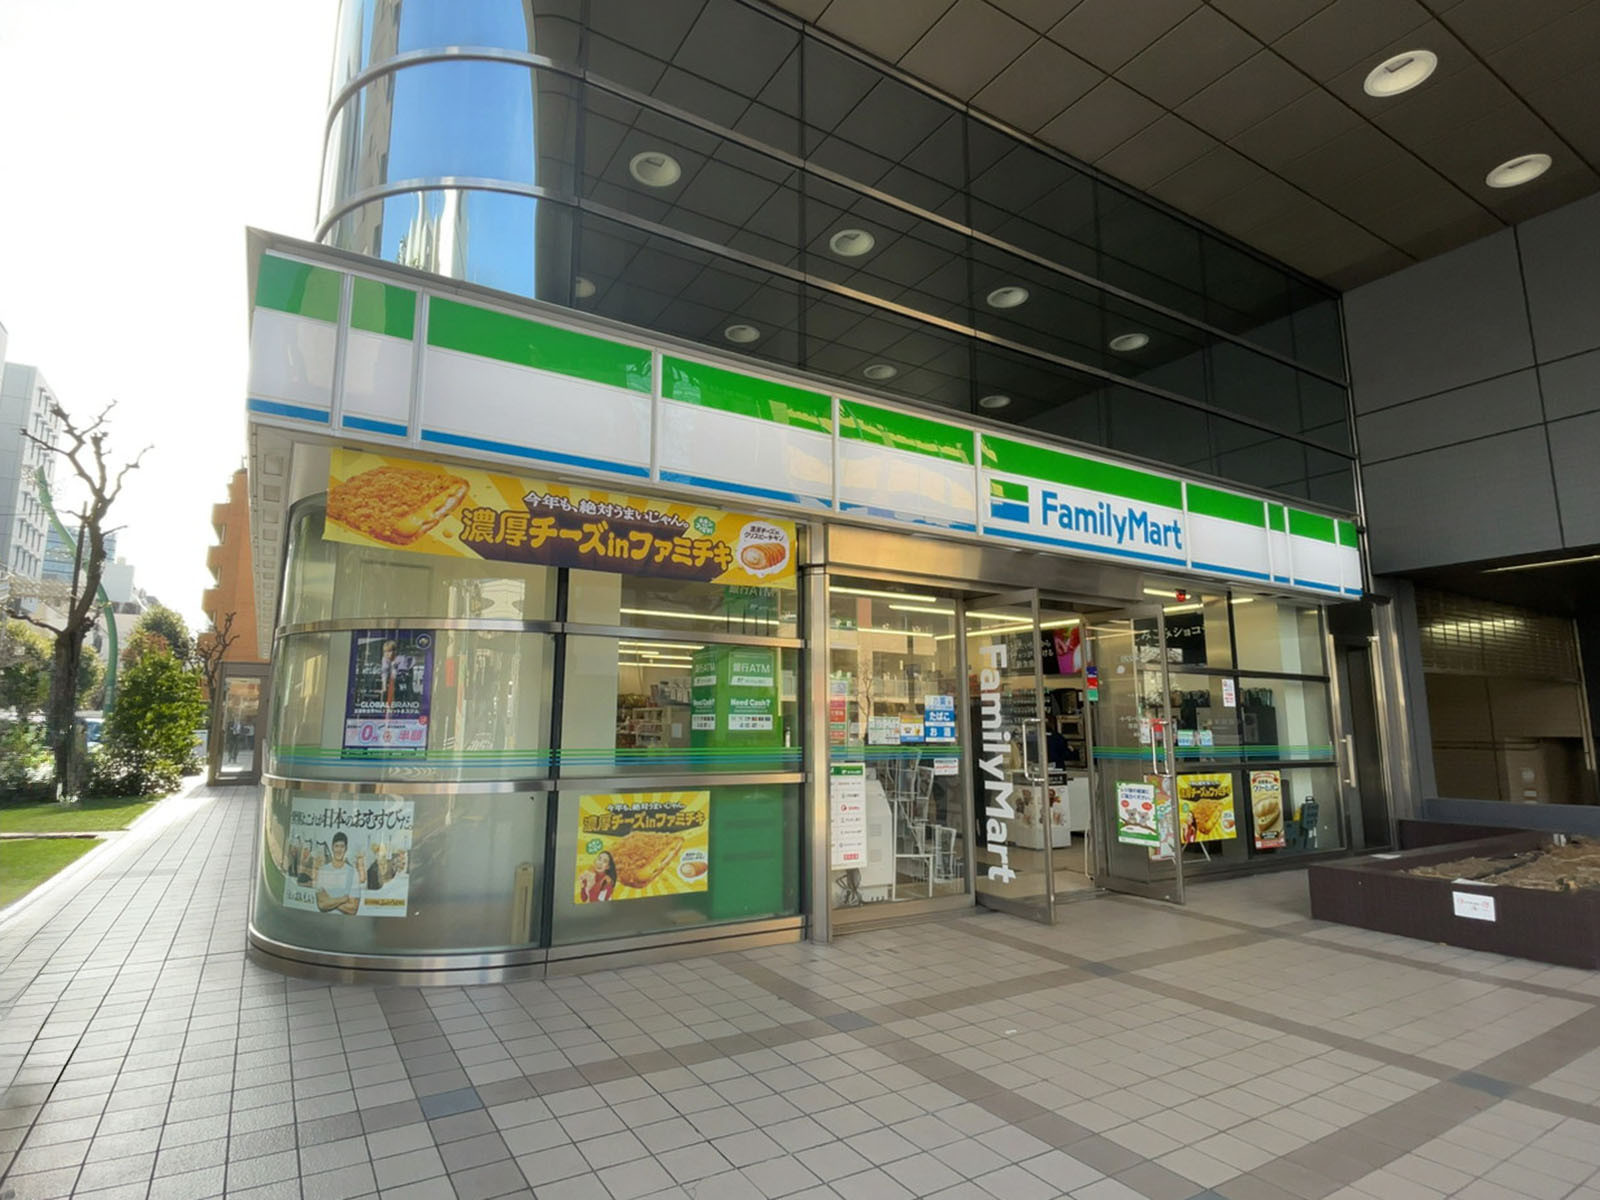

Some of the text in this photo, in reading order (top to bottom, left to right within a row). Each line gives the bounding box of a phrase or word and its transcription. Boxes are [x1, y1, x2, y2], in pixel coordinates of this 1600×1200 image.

[523, 490, 689, 528] 今年も、絶対うまいじゃん。
[1041, 490, 1183, 550] FamilyMart
[460, 508, 733, 570] 濃厚チーズinファミチキ
[730, 698, 771, 707] Need Cash?
[929, 711, 951, 722] たばこ
[979, 643, 1017, 884] FamilyMart
[582, 810, 706, 832] 濃厚チーズinファミチキ
